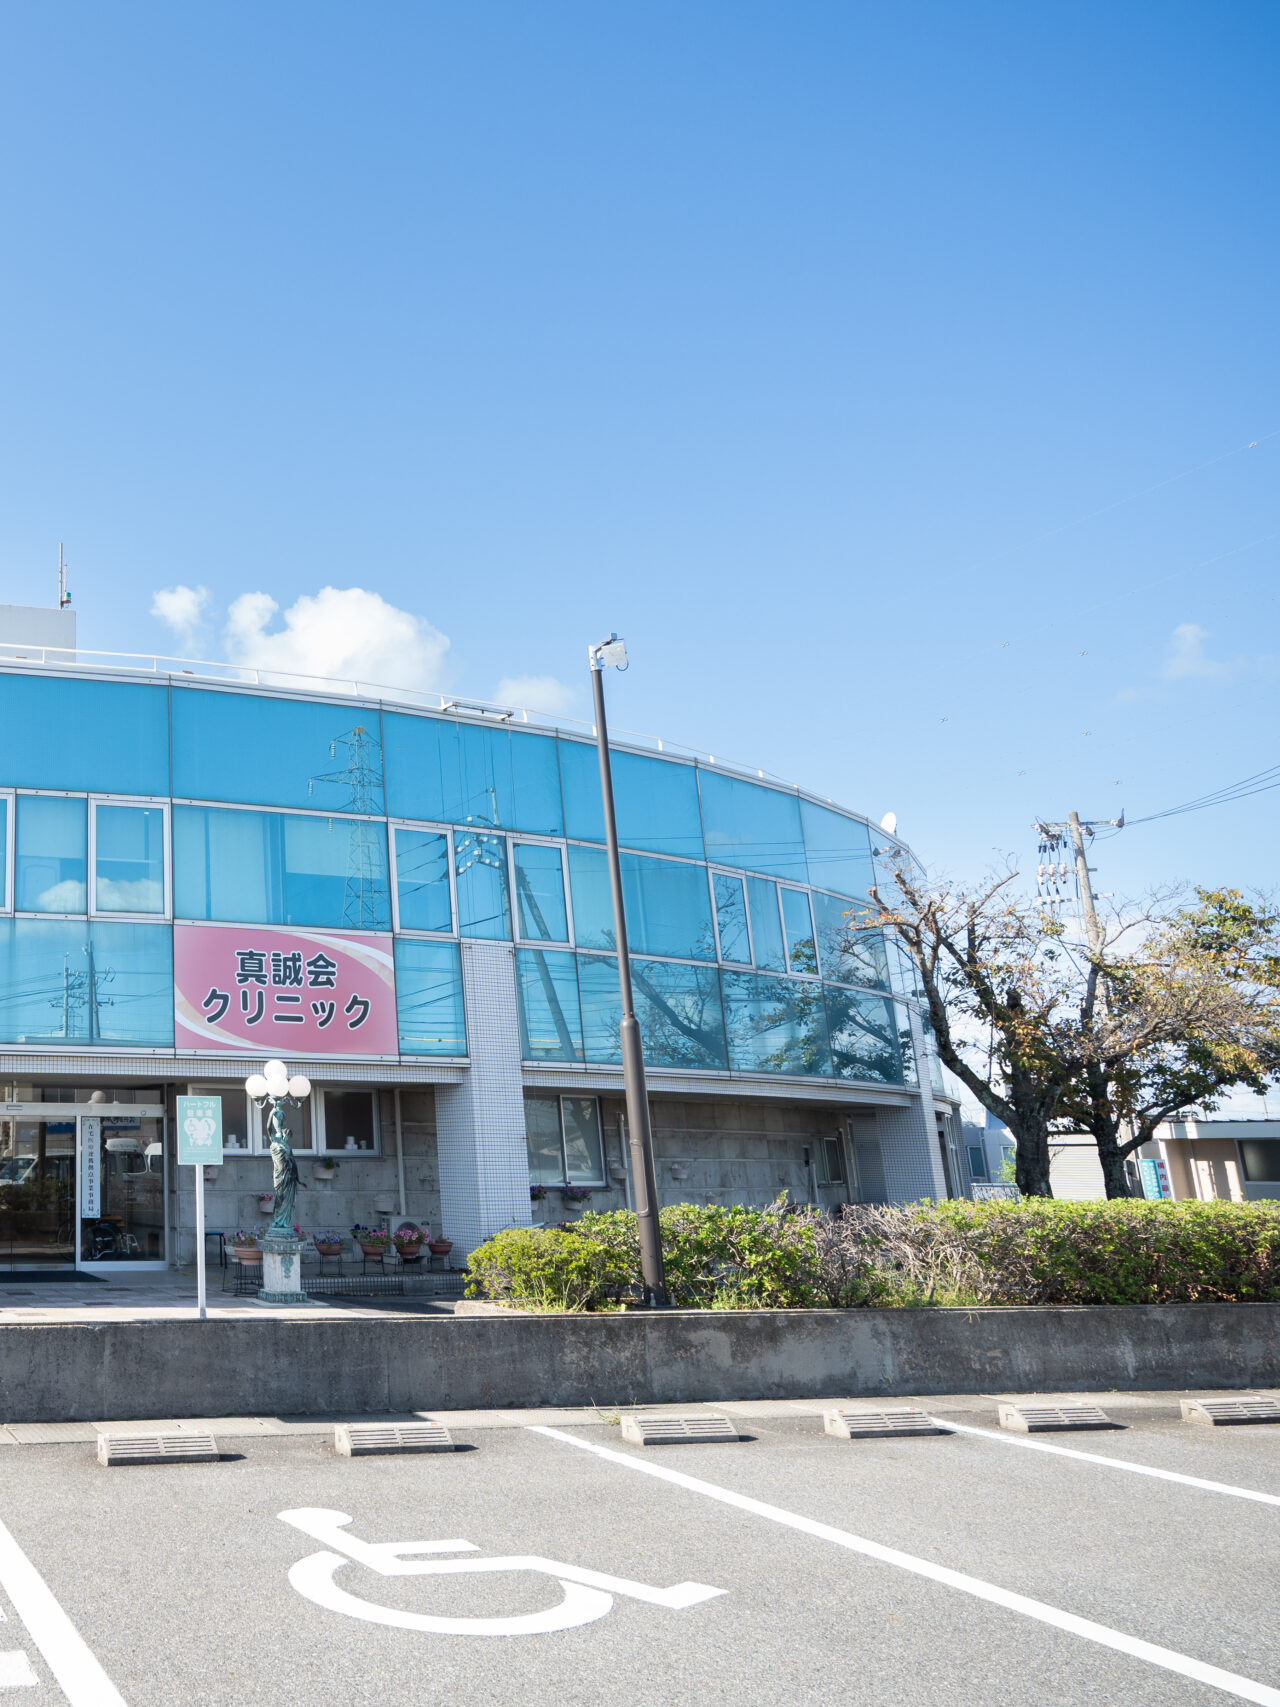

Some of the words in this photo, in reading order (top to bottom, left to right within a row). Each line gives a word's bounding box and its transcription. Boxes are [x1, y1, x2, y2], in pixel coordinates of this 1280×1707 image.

[235, 949, 337, 988] 真誠会
[203, 988, 371, 1029] クリニック
